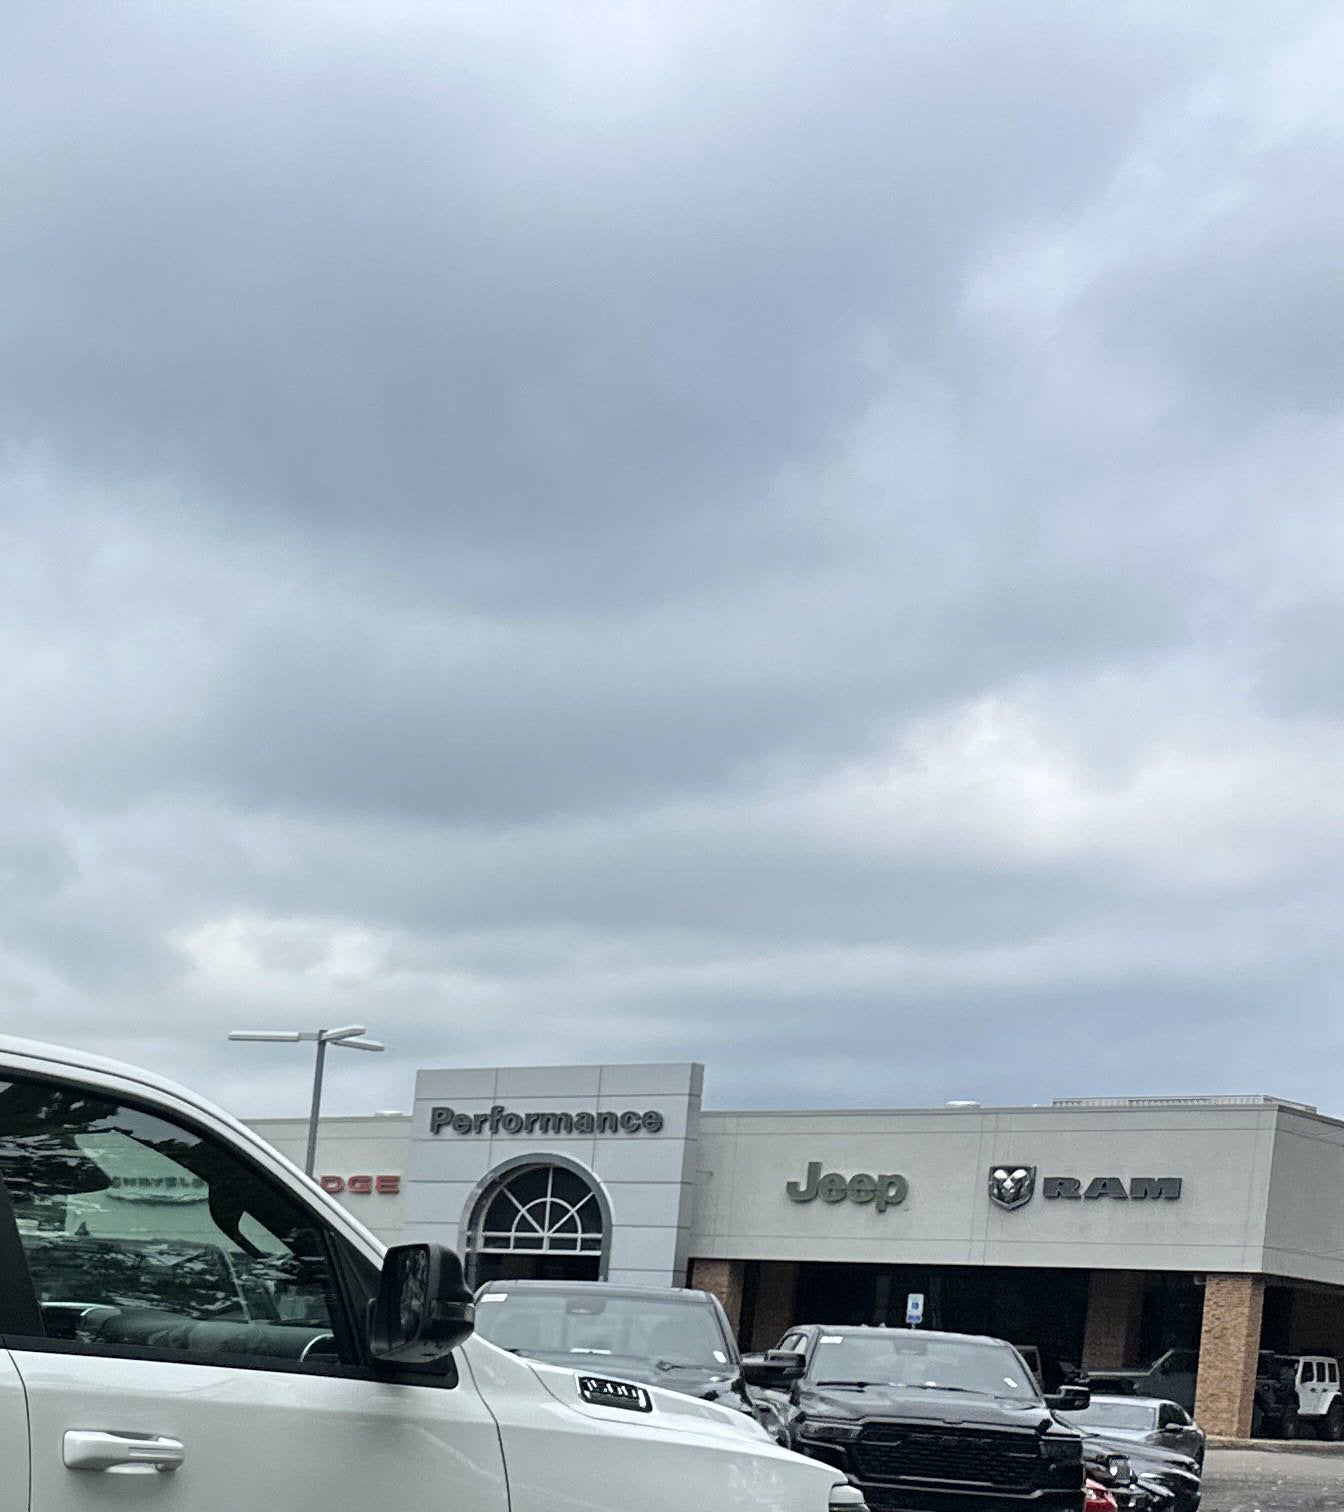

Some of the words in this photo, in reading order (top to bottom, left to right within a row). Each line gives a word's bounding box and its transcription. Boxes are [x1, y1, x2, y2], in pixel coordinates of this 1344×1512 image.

[430, 1105, 664, 1135] Performance
[319, 1175, 401, 1194] DGE
[786, 1162, 909, 1213] Jeep
[1043, 1177, 1183, 1200] RAM
